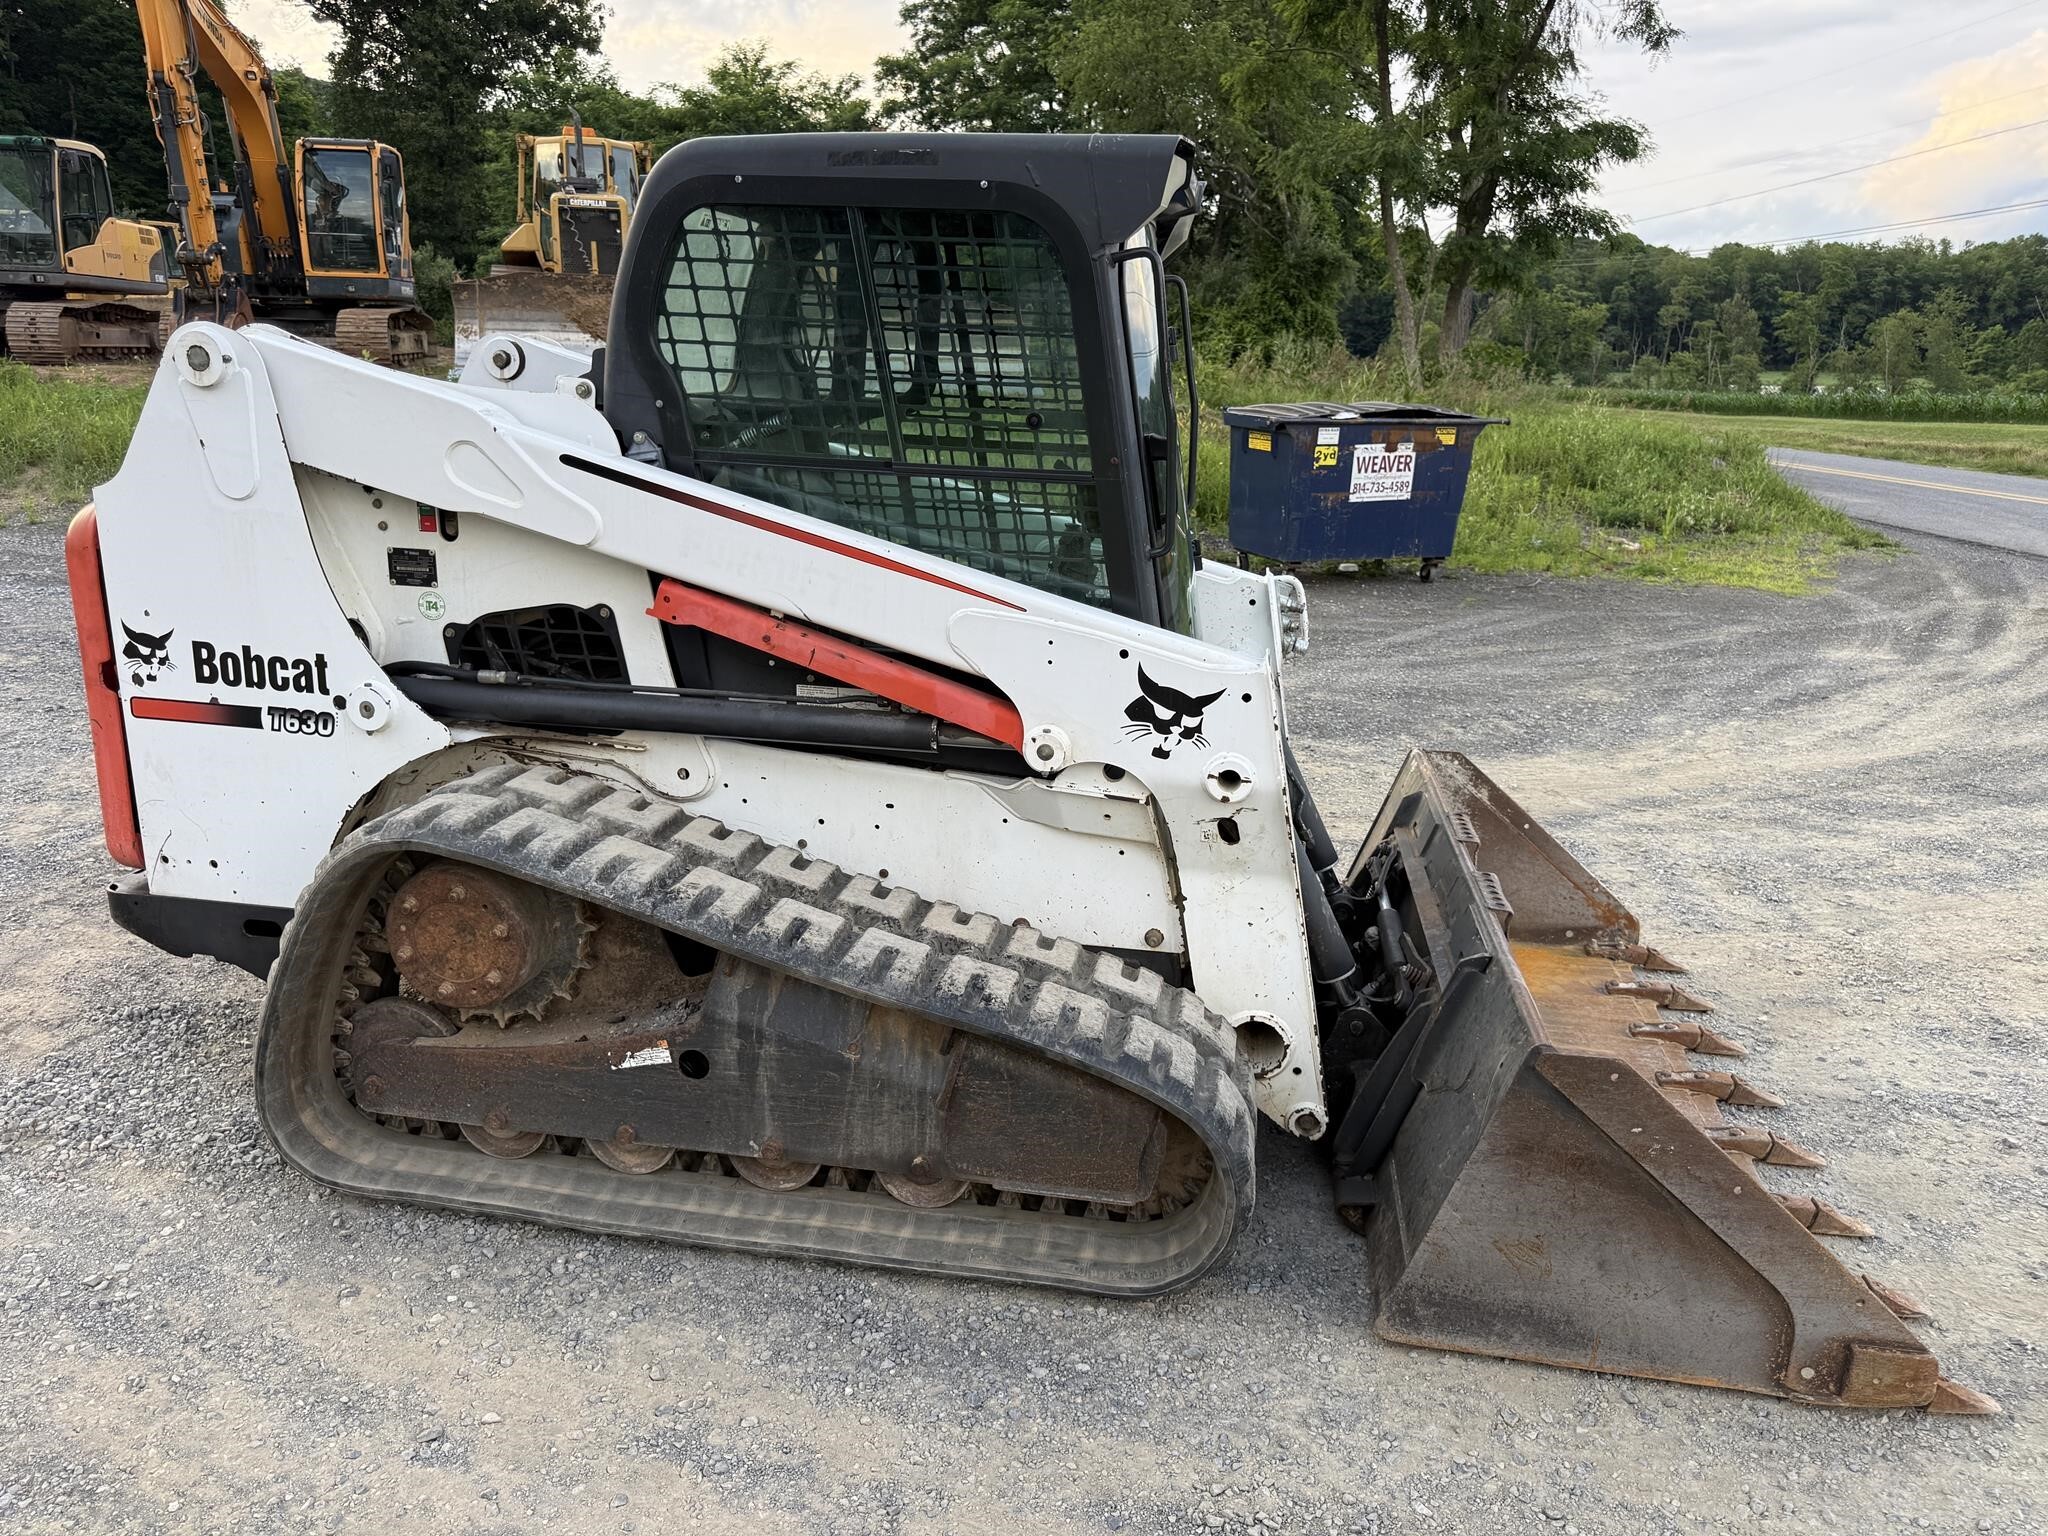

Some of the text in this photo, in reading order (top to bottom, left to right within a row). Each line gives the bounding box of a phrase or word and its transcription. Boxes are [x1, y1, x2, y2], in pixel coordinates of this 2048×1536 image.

[570, 198, 607, 207] CATERPILLAR
[1315, 449, 1337, 462] 2yd
[1356, 454, 1413, 475] WEAVER
[1352, 481, 1411, 494] 814-735-4589
[191, 640, 331, 696] Bobcat
[267, 706, 335, 737] T630
